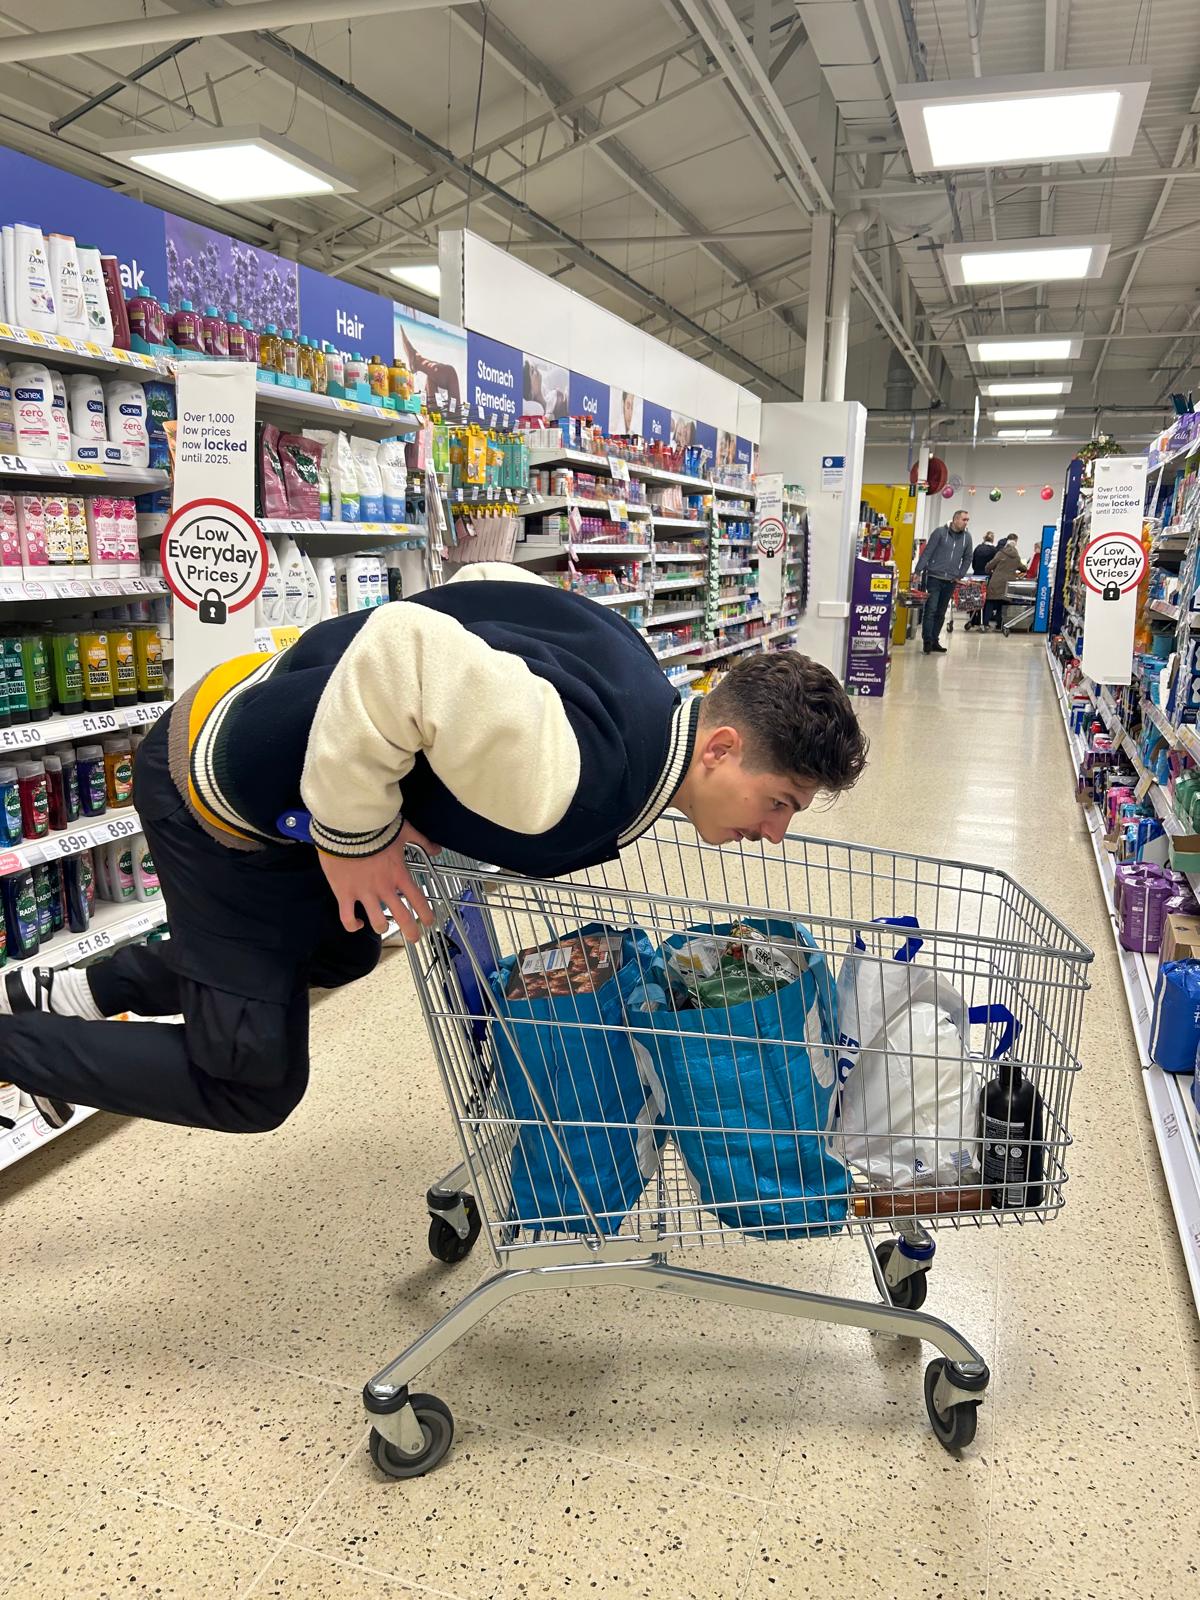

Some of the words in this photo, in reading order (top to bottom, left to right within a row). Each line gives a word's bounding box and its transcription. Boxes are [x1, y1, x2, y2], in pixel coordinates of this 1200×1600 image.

[336, 309, 364, 341] Hair
[477, 359, 514, 389] Stomach
[17, 389, 41, 400] Sanex
[475, 386, 516, 415] Remedies
[121, 405, 141, 416] Sanex
[582, 395, 598, 414] Cold
[19, 407, 44, 418] zero
[151, 409, 169, 418] RADOX
[183, 411, 207, 422] Over
[208, 412, 235, 424] 1,000
[90, 419, 104, 429] zero
[123, 423, 142, 432] zero
[182, 425, 199, 436] low
[201, 427, 231, 438] prices
[182, 440, 202, 449] now
[204, 438, 248, 452] locked
[79, 448, 97, 457] Sanex
[107, 448, 121, 458] Sanex
[181, 453, 202, 463] until
[204, 454, 231, 465] 2025.
[2, 455, 28, 472] £4
[1110, 493, 1130, 501] prices
[1111, 499, 1140, 507] locked
[291, 521, 305, 531] £3
[196, 525, 229, 542] Low
[169, 539, 259, 569] Everyday
[1104, 546, 1125, 556] Low
[1085, 556, 1142, 572] Everyday
[187, 565, 239, 584] Prices
[1097, 569, 1129, 579] Prices
[132, 581, 146, 591] £1
[856, 605, 887, 615] RAPID
[258, 643, 269, 653] £3
[136, 705, 165, 721] £1.50
[83, 714, 116, 732] £1.50
[3, 728, 41, 745] £1.50
[107, 818, 136, 838] 89p
[58, 833, 88, 854] 89p
[37, 891, 52, 903] RADOX
[19, 904, 37, 917] RADOX
[78, 932, 111, 956] £1.85
